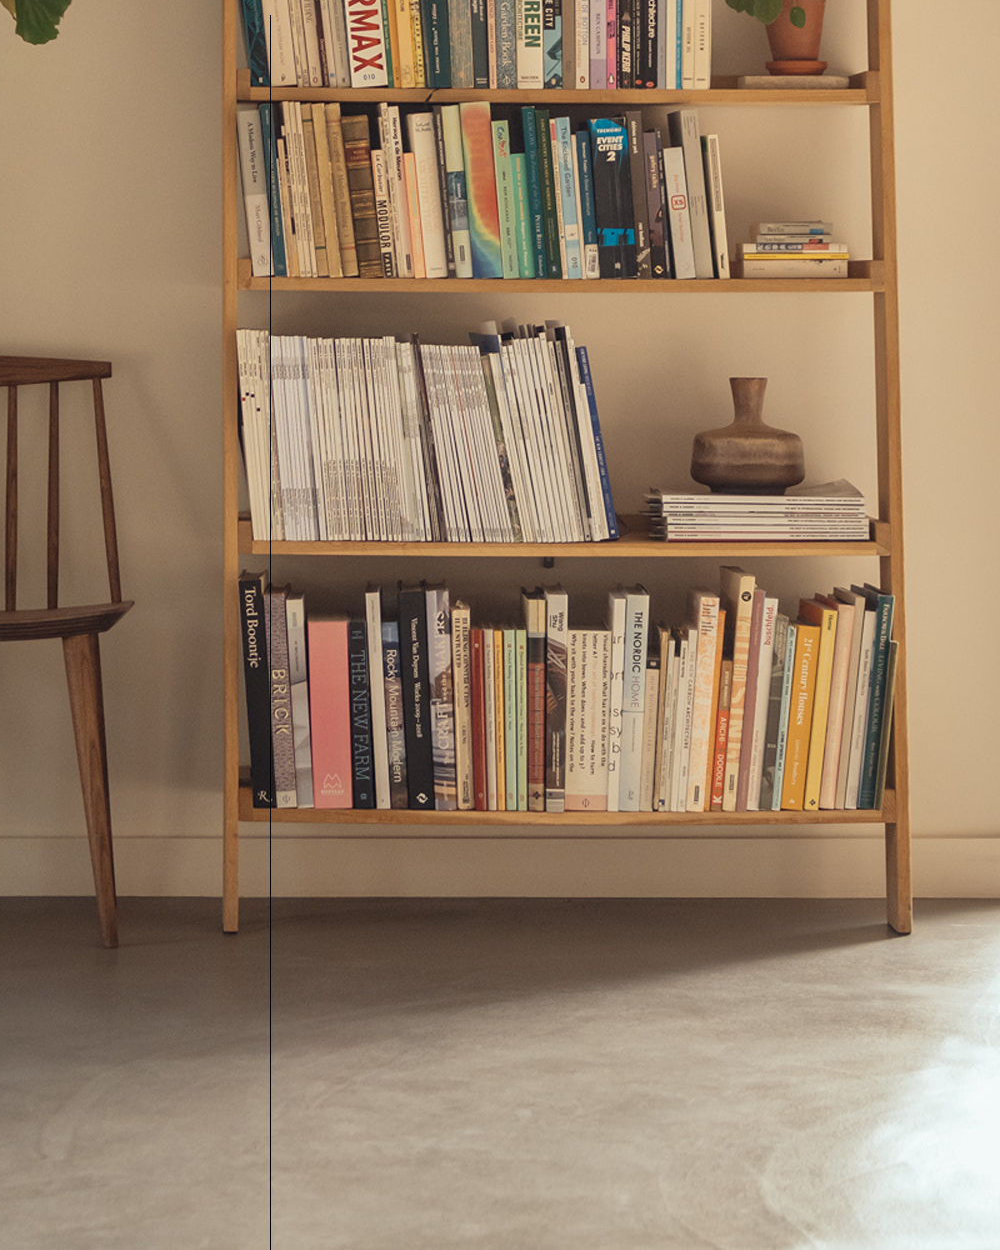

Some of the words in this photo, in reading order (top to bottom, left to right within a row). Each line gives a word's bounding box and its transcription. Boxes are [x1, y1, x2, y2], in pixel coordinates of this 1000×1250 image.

[500, 1, 511, 38] Garden
[544, 7, 553, 27] CITY
[621, 25, 630, 51] PHILIP
[501, 40, 512, 66] Book
[621, 51, 631, 72] KERR
[363, 73, 375, 81] 010
[246, 127, 255, 150] Modern
[560, 126, 568, 139] The
[596, 135, 624, 144] EVENT
[248, 150, 256, 163] Way
[374, 153, 382, 162] Le
[390, 116, 399, 140] Herzog
[395, 155, 403, 180] Meuron
[561, 140, 570, 171] Enclosed
[597, 143, 623, 152] CITIES
[606, 151, 616, 162] 2
[375, 162, 385, 192] Corbusier
[563, 172, 572, 197] Garden
[255, 219, 264, 242] Gibberd
[376, 199, 391, 248] MODULOR
[534, 214, 542, 233] PETER
[535, 233, 543, 249] REED
[536, 254, 544, 276] Edinburgh
[244, 586, 258, 616] Tord
[410, 617, 419, 641] Vincent
[556, 611, 564, 631] Wang
[633, 611, 643, 629] THE
[762, 603, 774, 645] buschfeld.
[826, 614, 834, 631] Home
[244, 618, 261, 669] Boontje
[411, 641, 419, 654] Van
[432, 610, 446, 672] MAKERS
[632, 631, 642, 673] NORDIC
[802, 636, 813, 652] 21st
[878, 634, 887, 650] BALL
[350, 649, 366, 685] THE
[384, 649, 398, 682] Rocky
[410, 654, 420, 678] Duysen
[797, 652, 811, 692] Century
[874, 654, 885, 684] LIVING
[462, 654, 470, 708] CONSTRUCTION
[630, 675, 640, 708] HOME
[271, 668, 290, 735] BRICK
[351, 689, 368, 731] NEW
[387, 684, 401, 737] Mountain
[795, 691, 808, 725] Houses
[869, 697, 880, 734] COLOUR
[436, 700, 450, 750] CRAFT
[683, 706, 691, 749] ARCHITECTURE
[717, 716, 727, 744] ARCHI-
[353, 733, 370, 781] FARM
[390, 739, 403, 782] Modern
[714, 753, 724, 787] DOODLE
[789, 761, 798, 785] Bradbury
